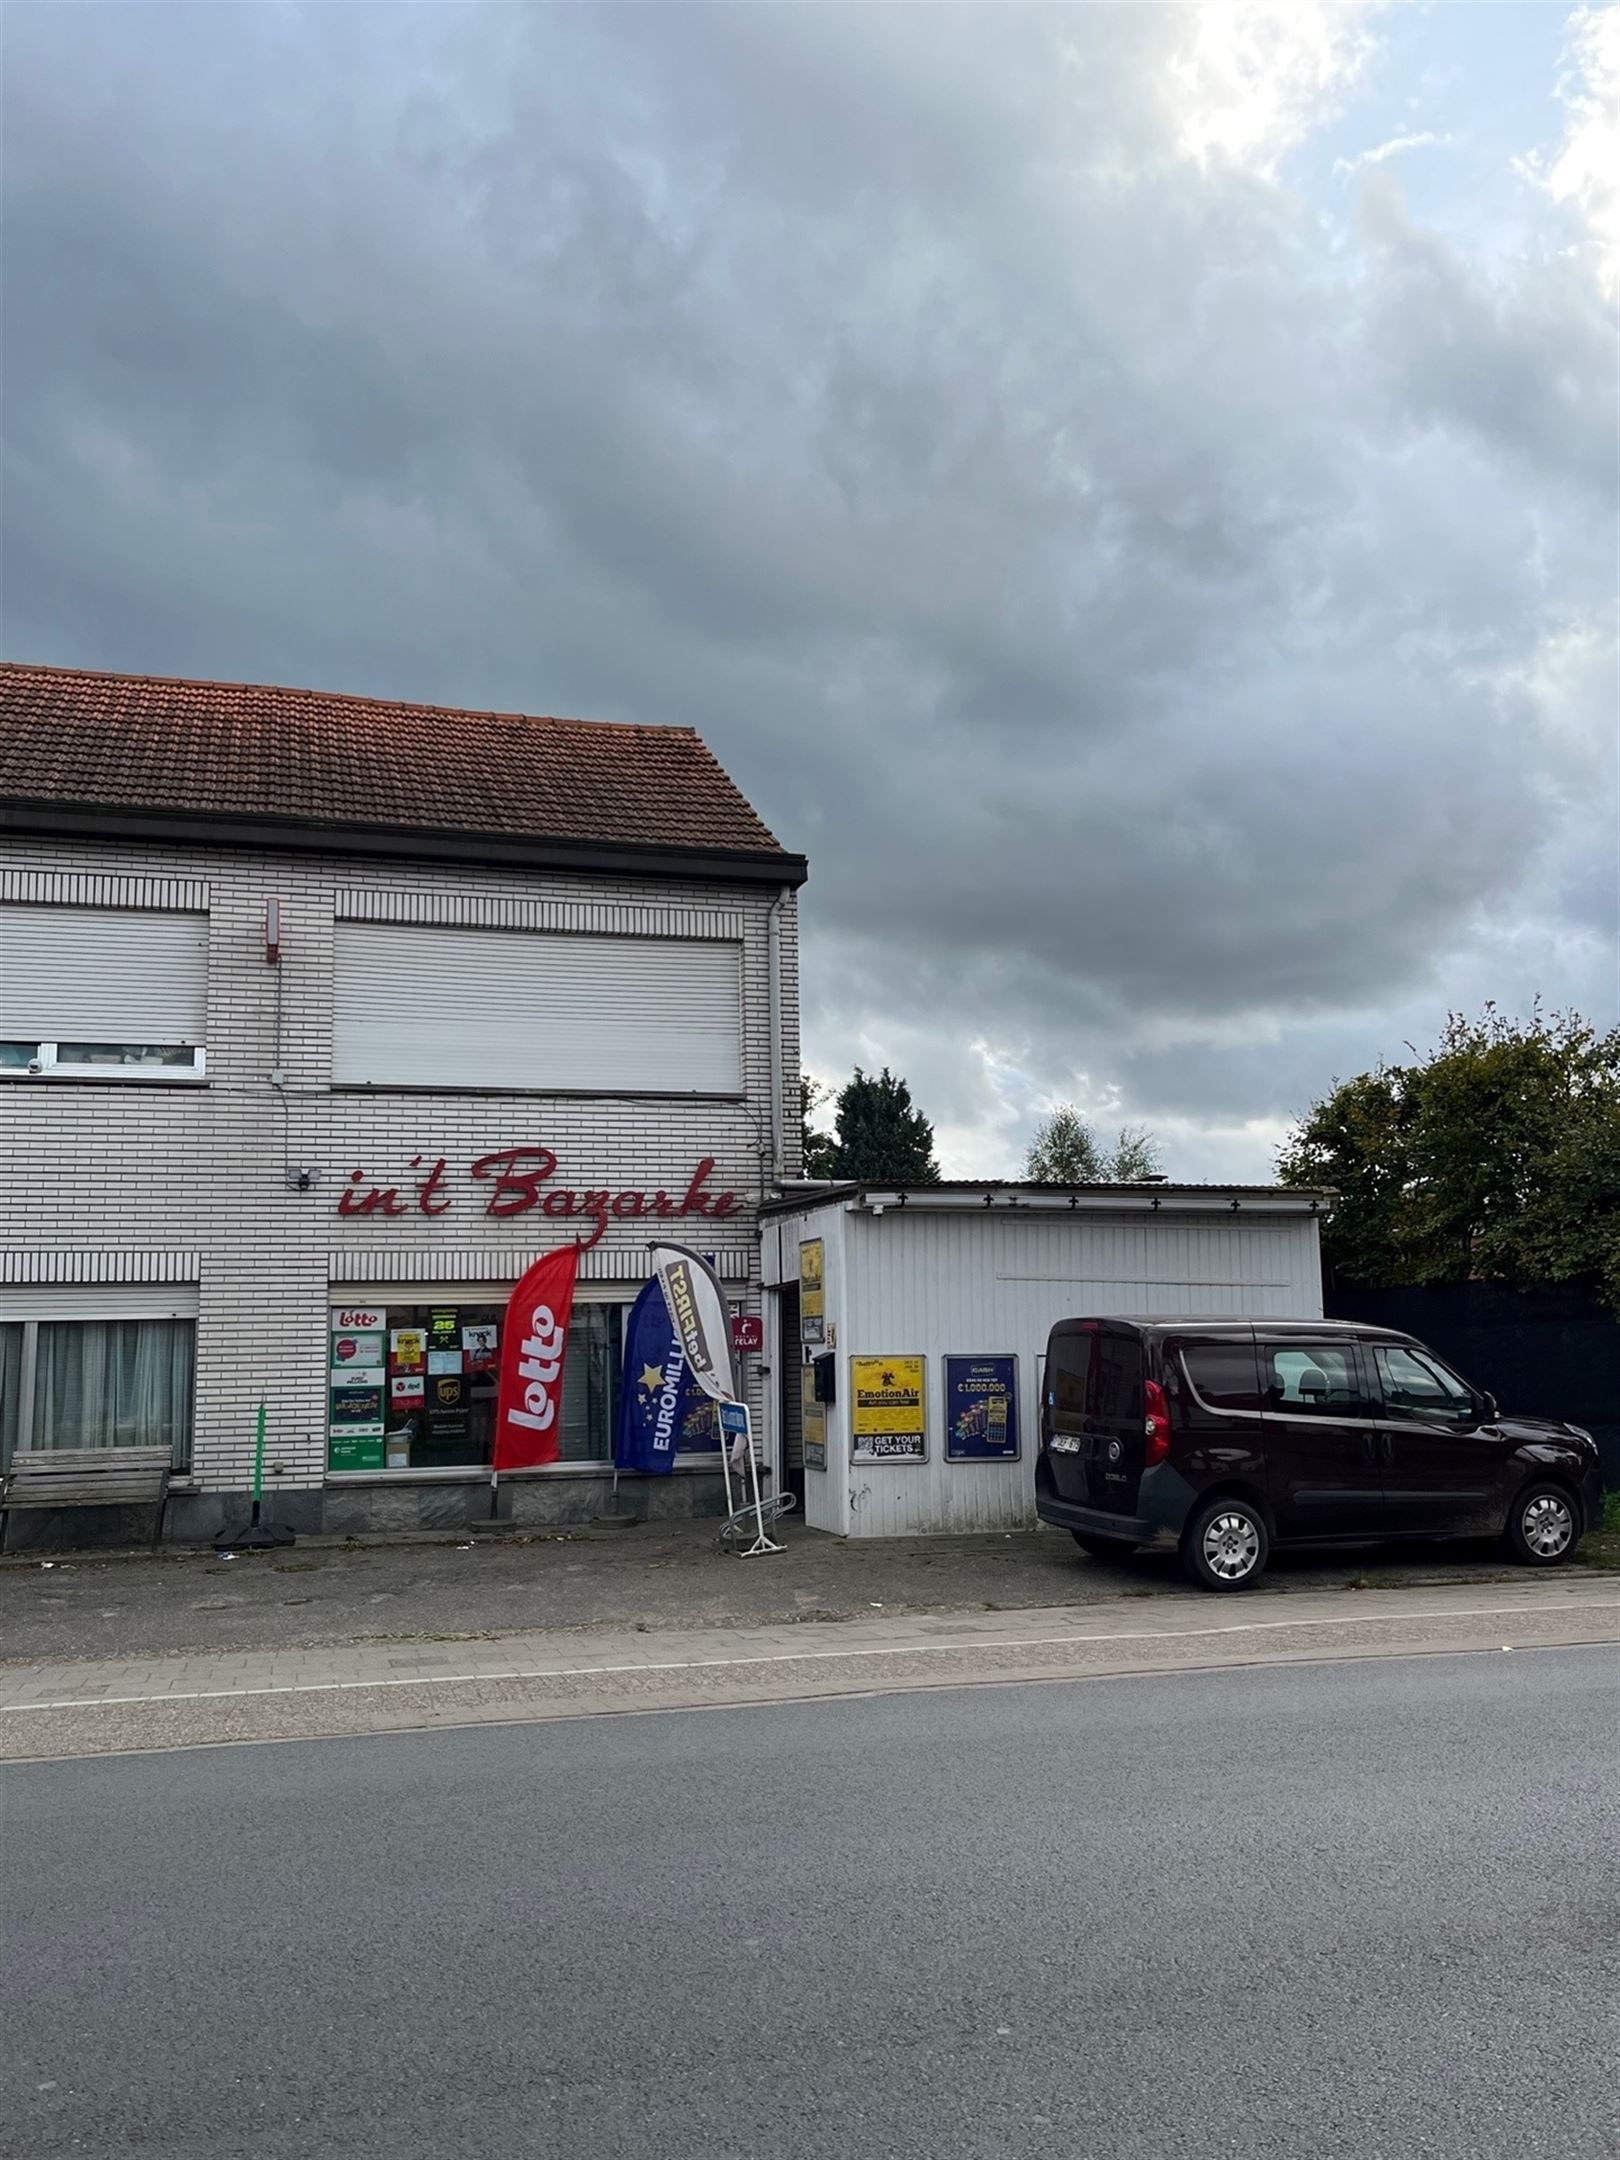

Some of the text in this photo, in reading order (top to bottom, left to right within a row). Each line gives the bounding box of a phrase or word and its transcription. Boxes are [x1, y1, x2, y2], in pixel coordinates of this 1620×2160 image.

[471, 1146, 744, 1251] Bazarke
[339, 1311, 378, 1328] Lotto
[433, 1320, 455, 1330] 25
[507, 1304, 564, 1431] Lotto
[440, 1386, 458, 1401] ups
[857, 1388, 919, 1398] EmotionAir
[874, 1435, 921, 1445] GET YOUR
[875, 1444, 913, 1453] TICKETS
